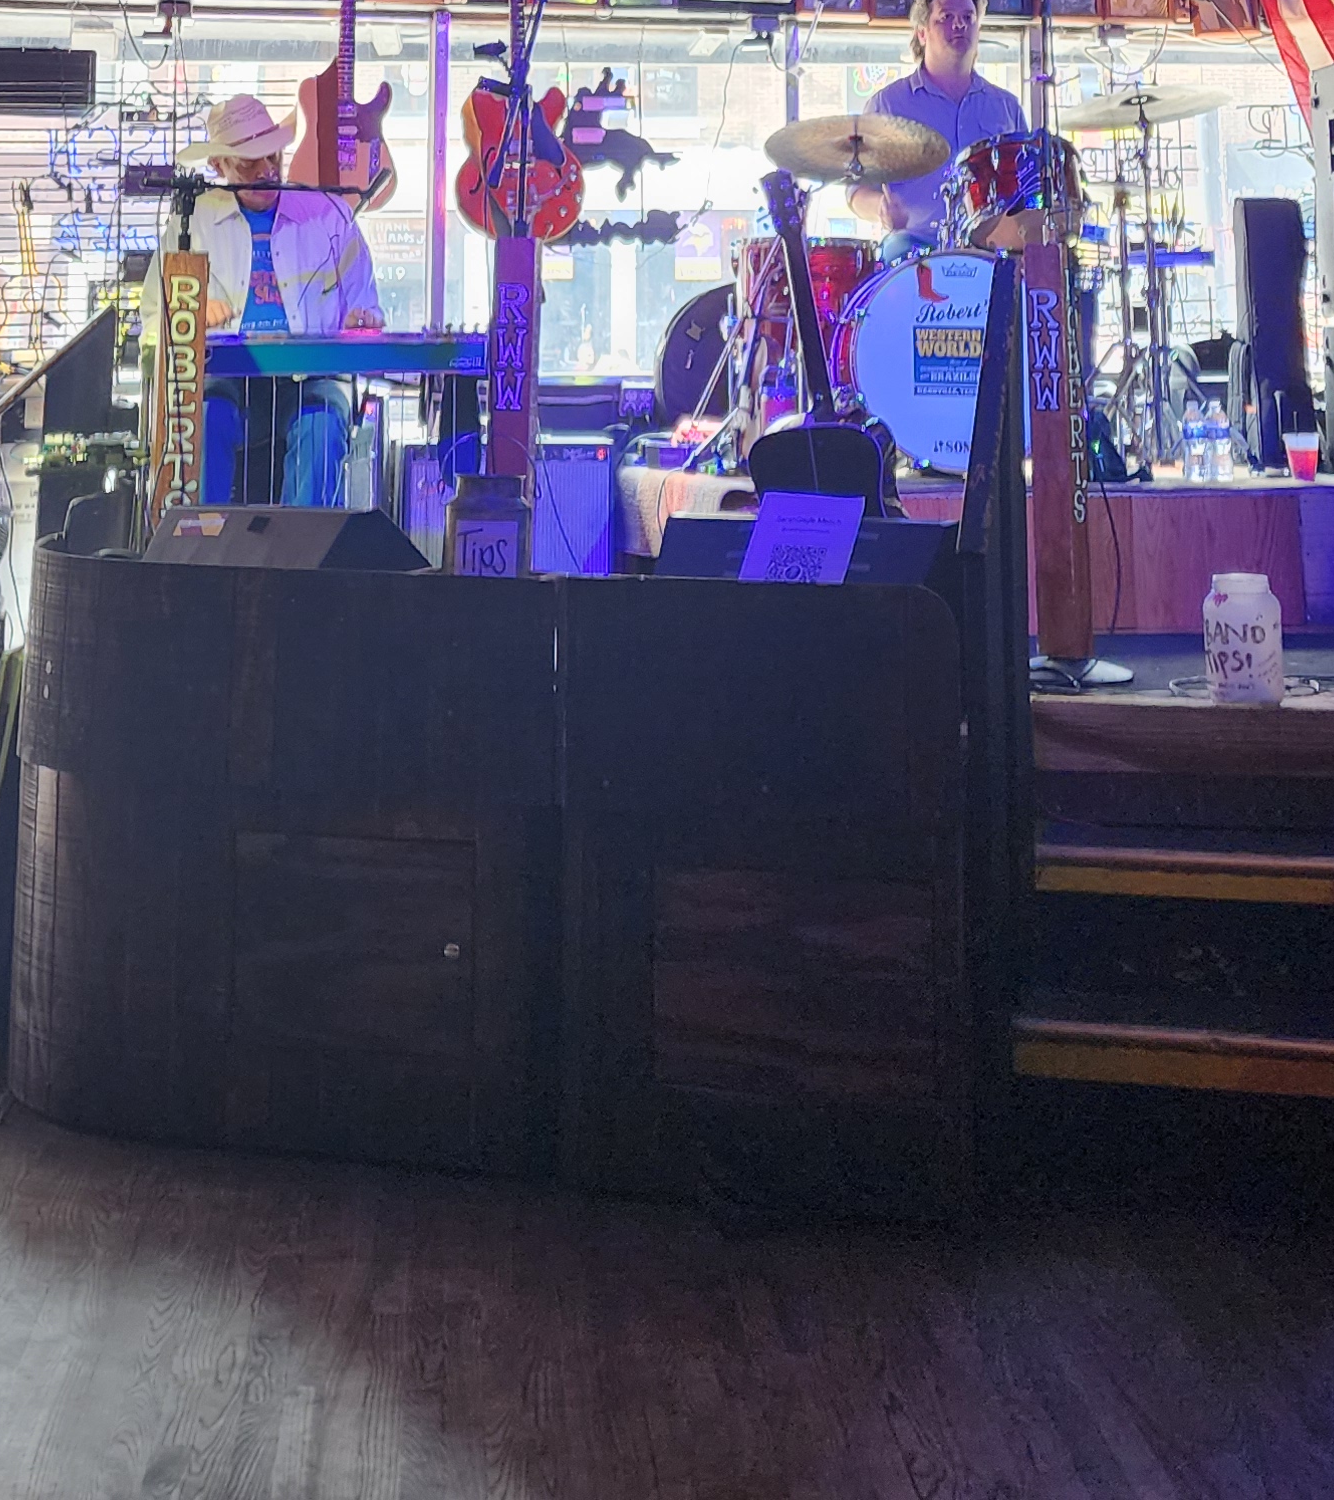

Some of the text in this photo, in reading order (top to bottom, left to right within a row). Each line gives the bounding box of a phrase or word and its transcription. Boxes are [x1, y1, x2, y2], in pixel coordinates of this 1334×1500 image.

[915, 299, 989, 324] Robert'
[494, 283, 529, 411] RWW
[915, 340, 983, 359] WORLD
[1028, 287, 1063, 412] RWW
[457, 527, 509, 576] Tips
[1205, 617, 1266, 648] BAND
[1205, 648, 1254, 680] TIPS!
